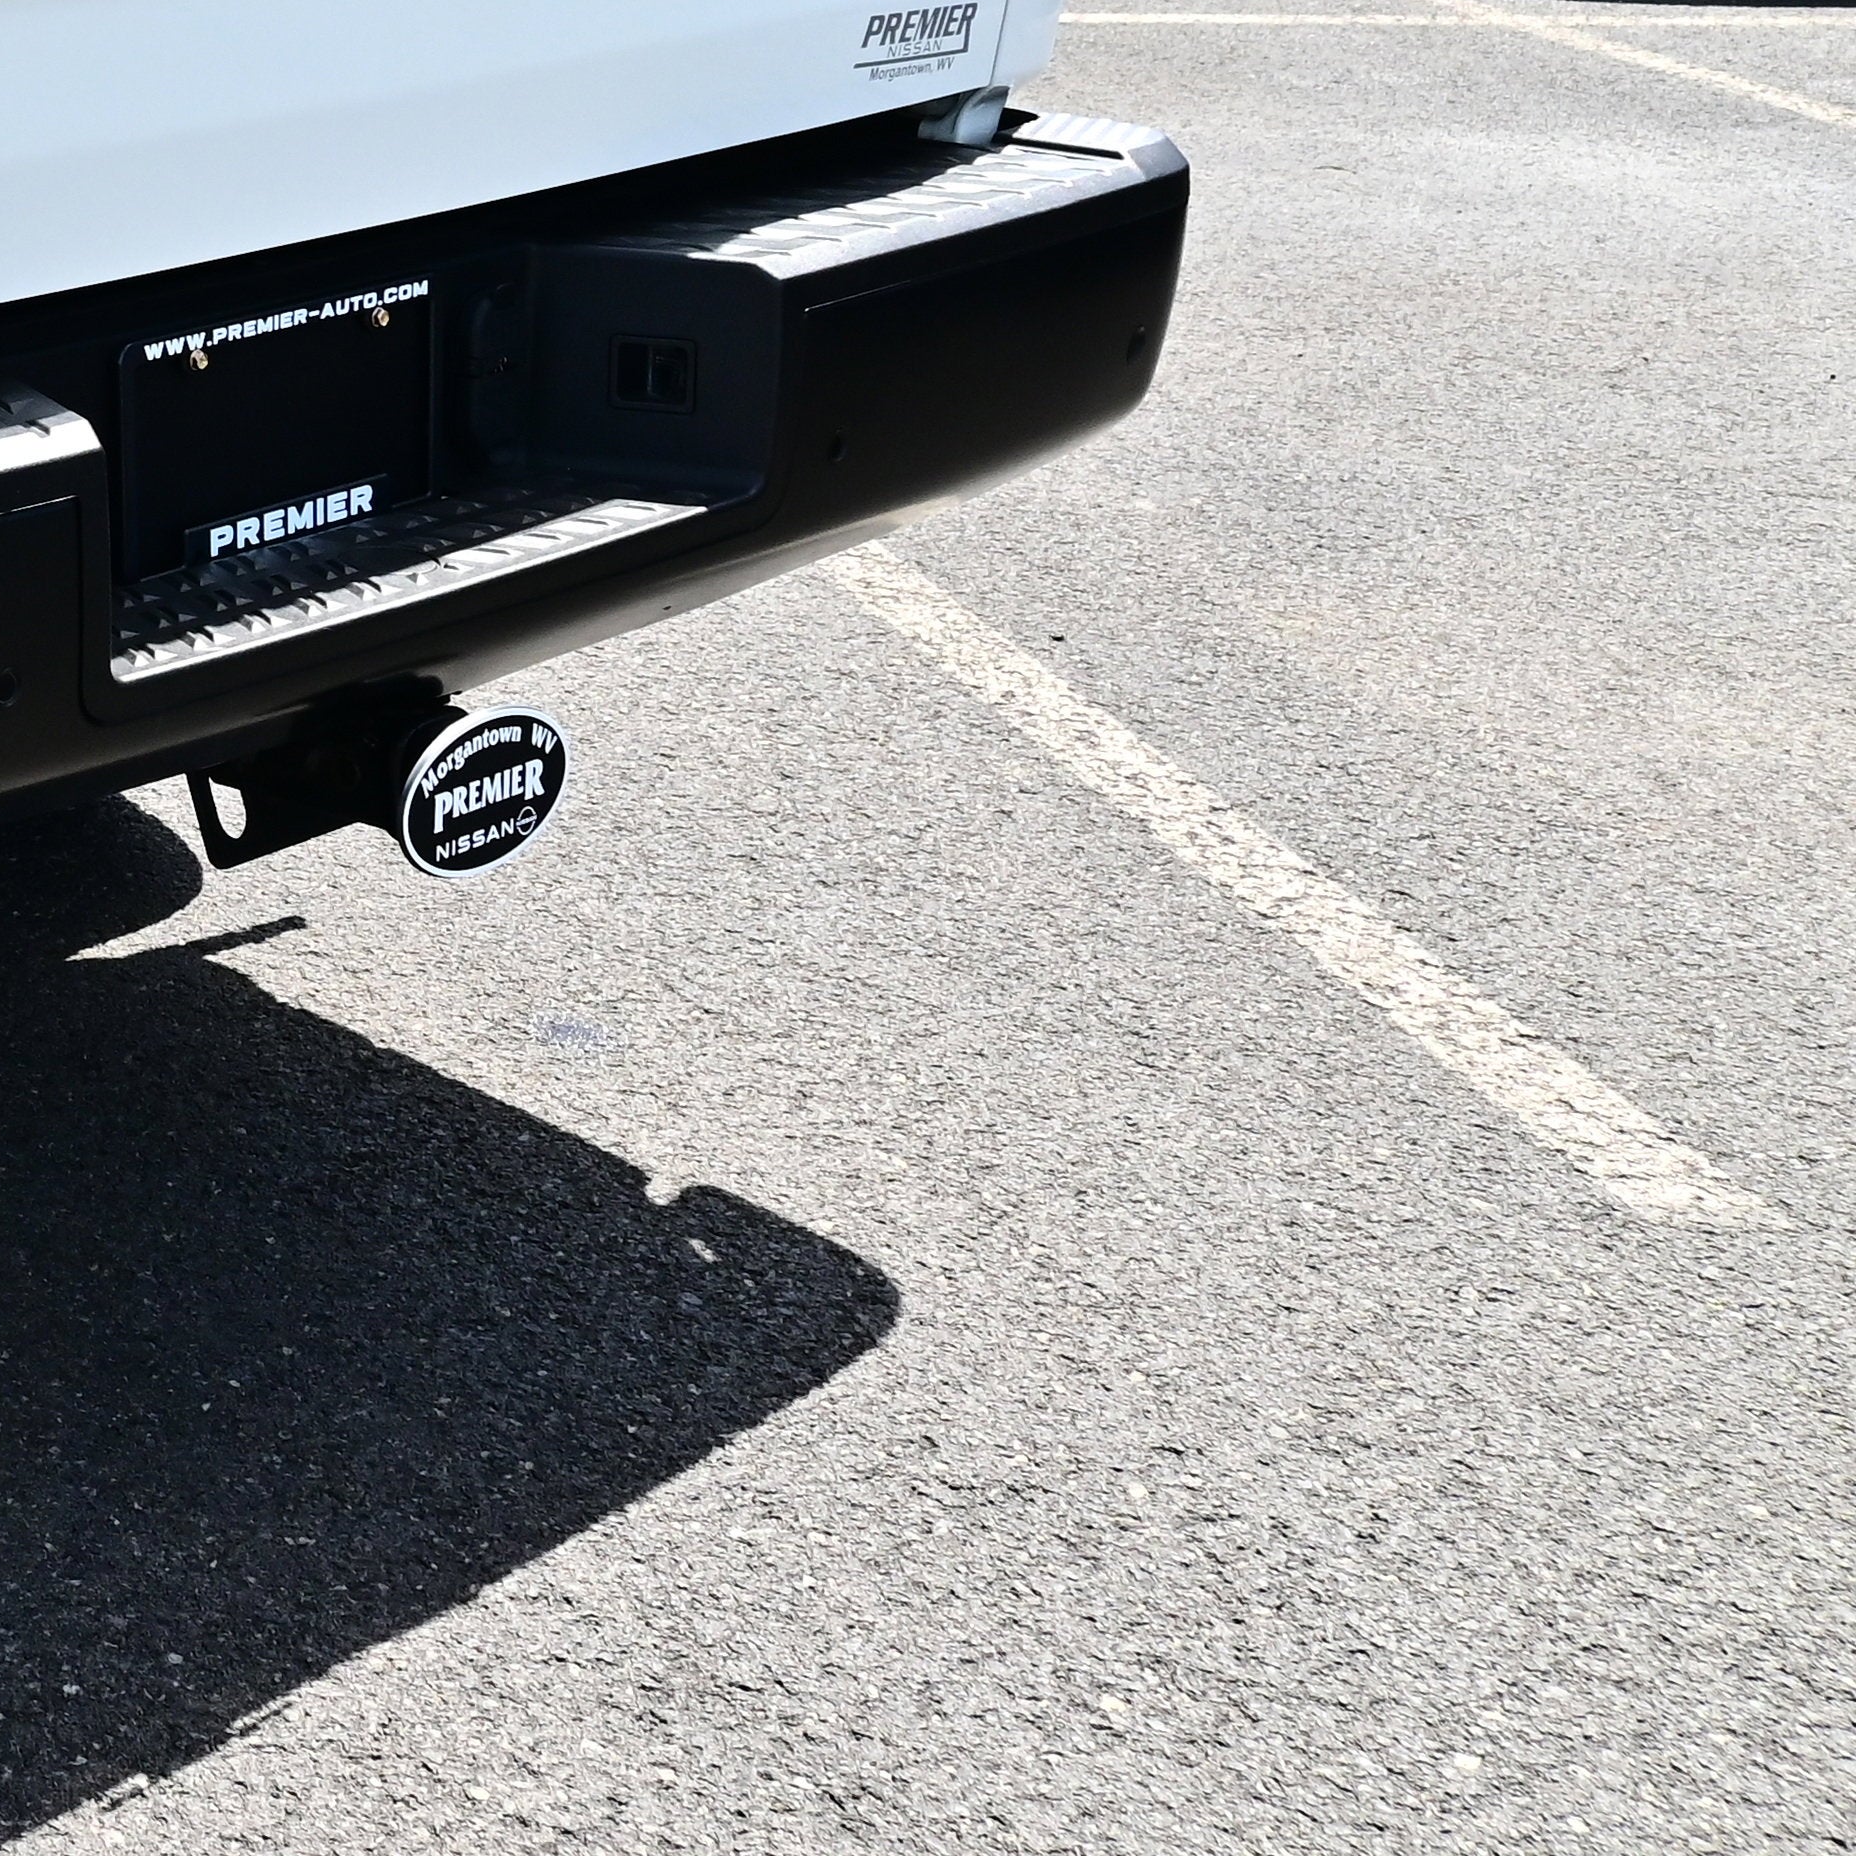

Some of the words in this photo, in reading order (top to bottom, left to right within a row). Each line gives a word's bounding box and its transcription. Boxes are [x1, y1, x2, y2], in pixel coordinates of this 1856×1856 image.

[860, 2, 979, 50] PREMIER
[887, 39, 943, 58] NISSAN
[868, 63, 934, 82] Morgantown,
[937, 57, 956, 71] WV
[143, 279, 429, 362] WWW.PREMIER-AUTO.COM
[209, 483, 374, 558] PREMIER
[419, 725, 523, 799] Morgantown
[530, 722, 559, 755] WV
[433, 758, 546, 834] PREMIER
[435, 817, 515, 862] NISSAN
